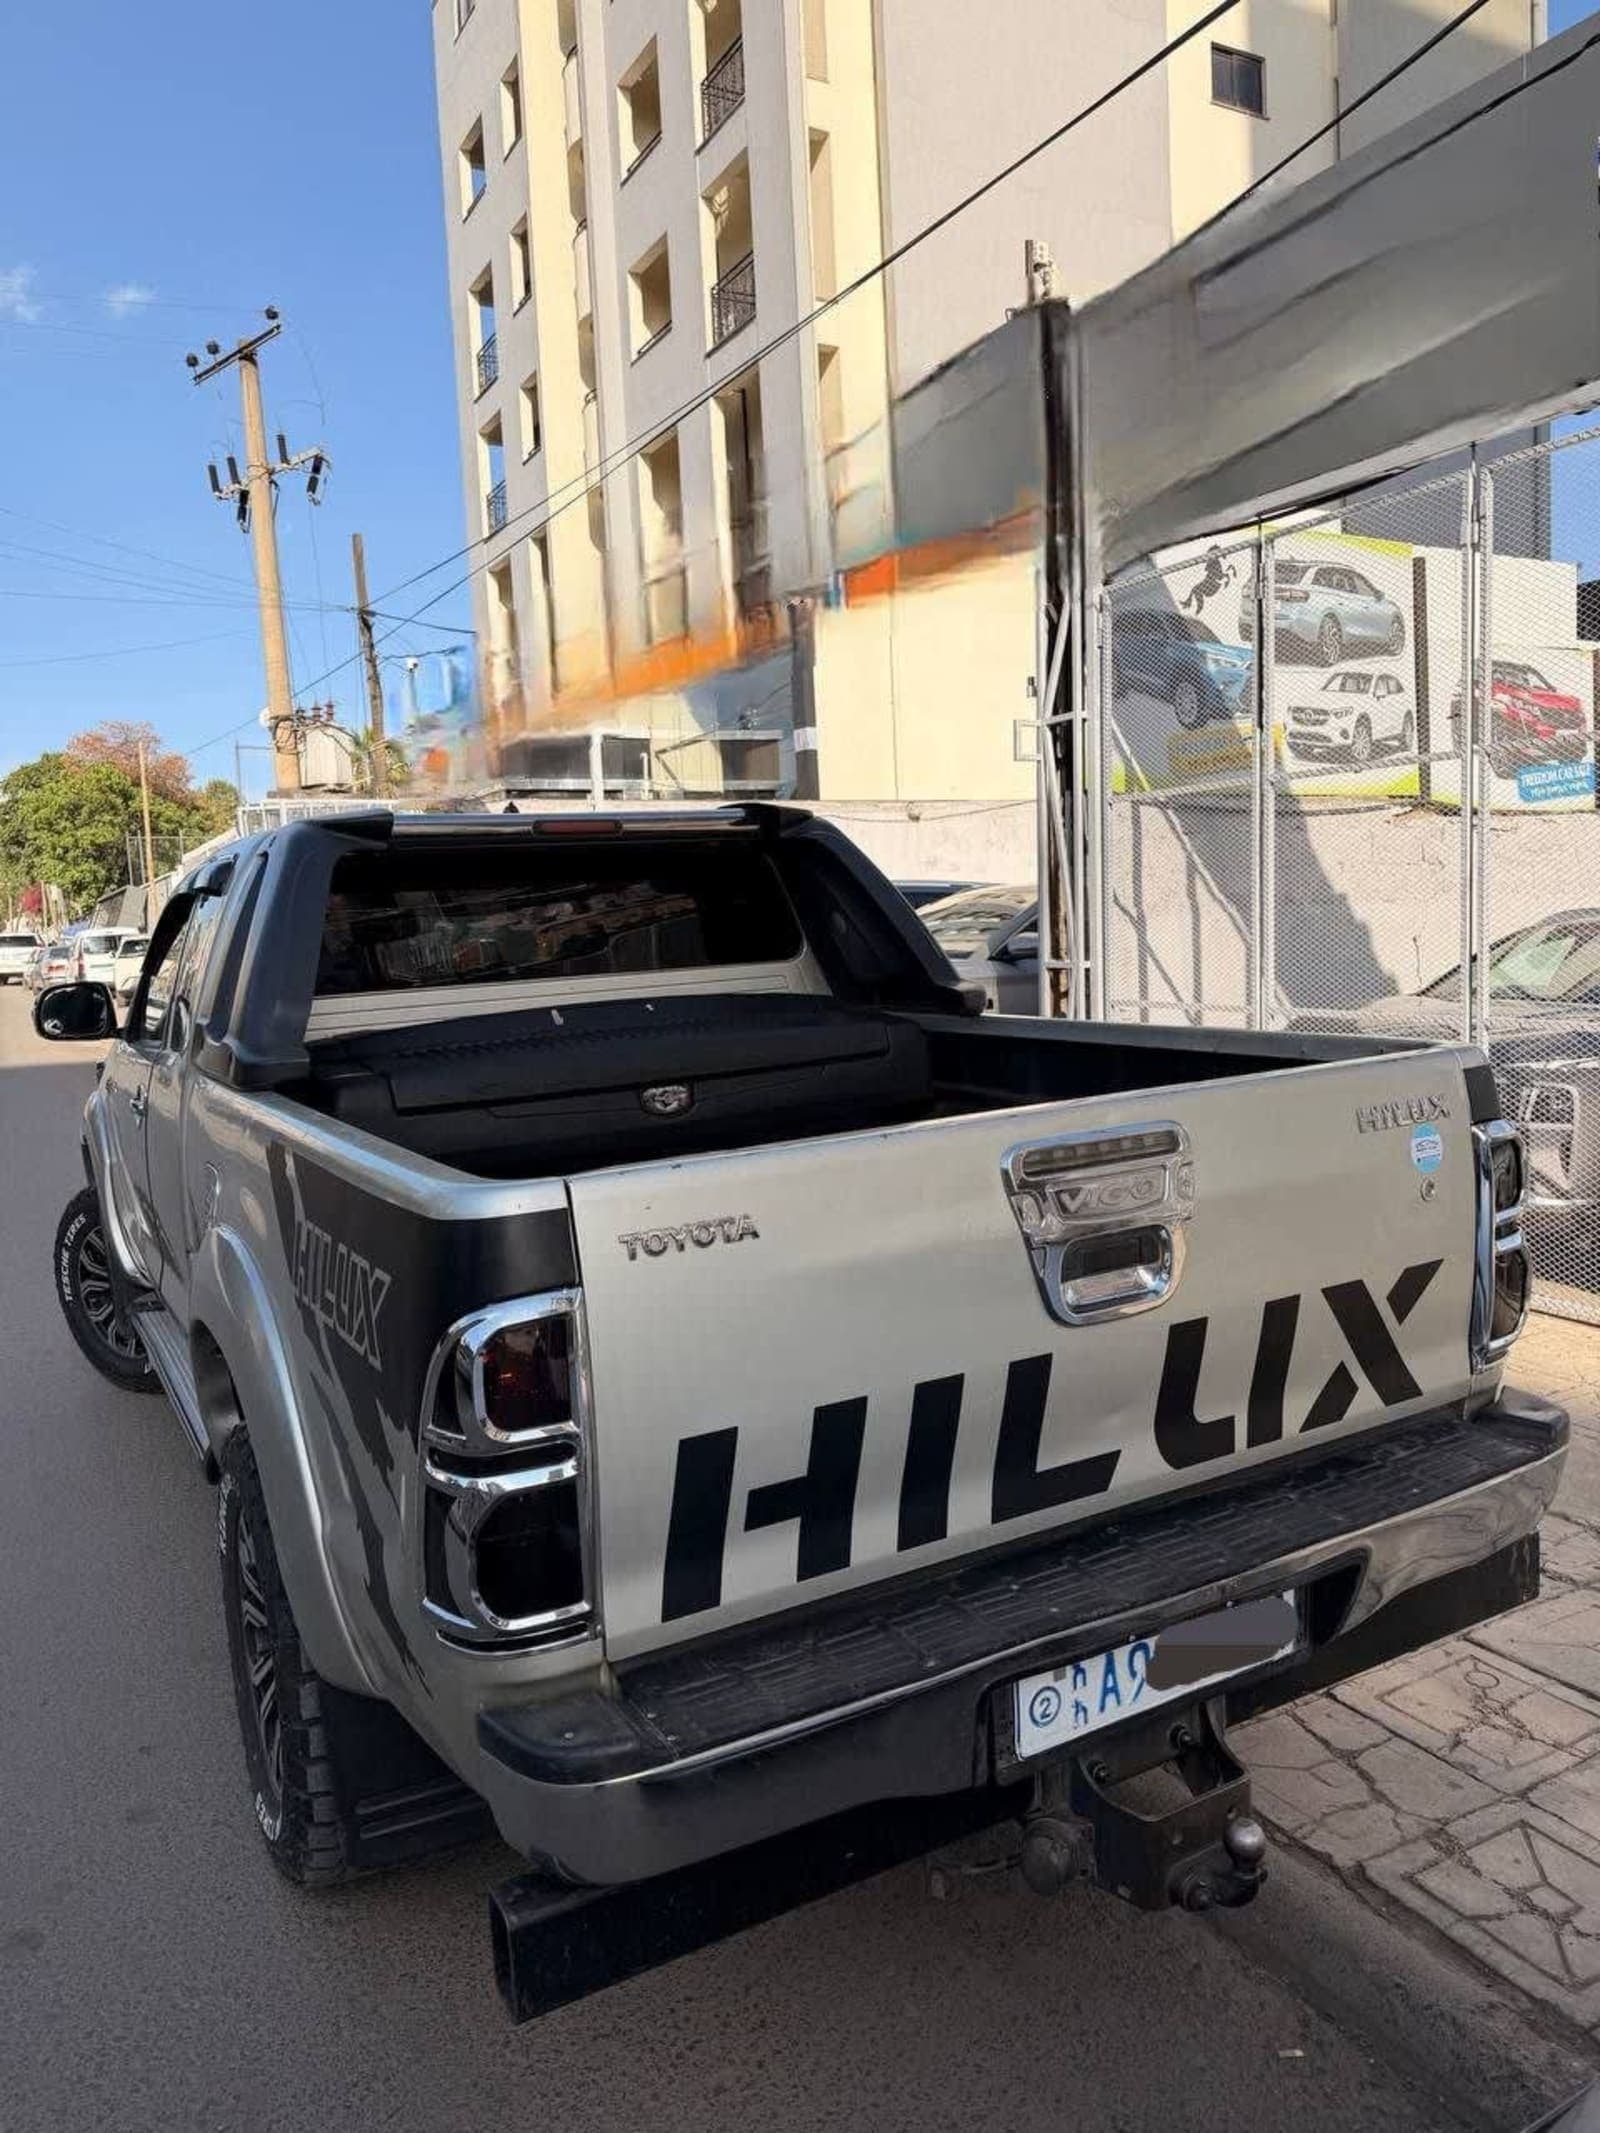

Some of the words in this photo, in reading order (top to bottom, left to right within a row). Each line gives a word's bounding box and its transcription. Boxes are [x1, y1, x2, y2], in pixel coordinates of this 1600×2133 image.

[1356, 1095, 1450, 1134] HILUX
[618, 1214, 760, 1261] TOYOTA
[293, 1218, 392, 1372] HILUX
[661, 1258, 1444, 1622] HILUX
